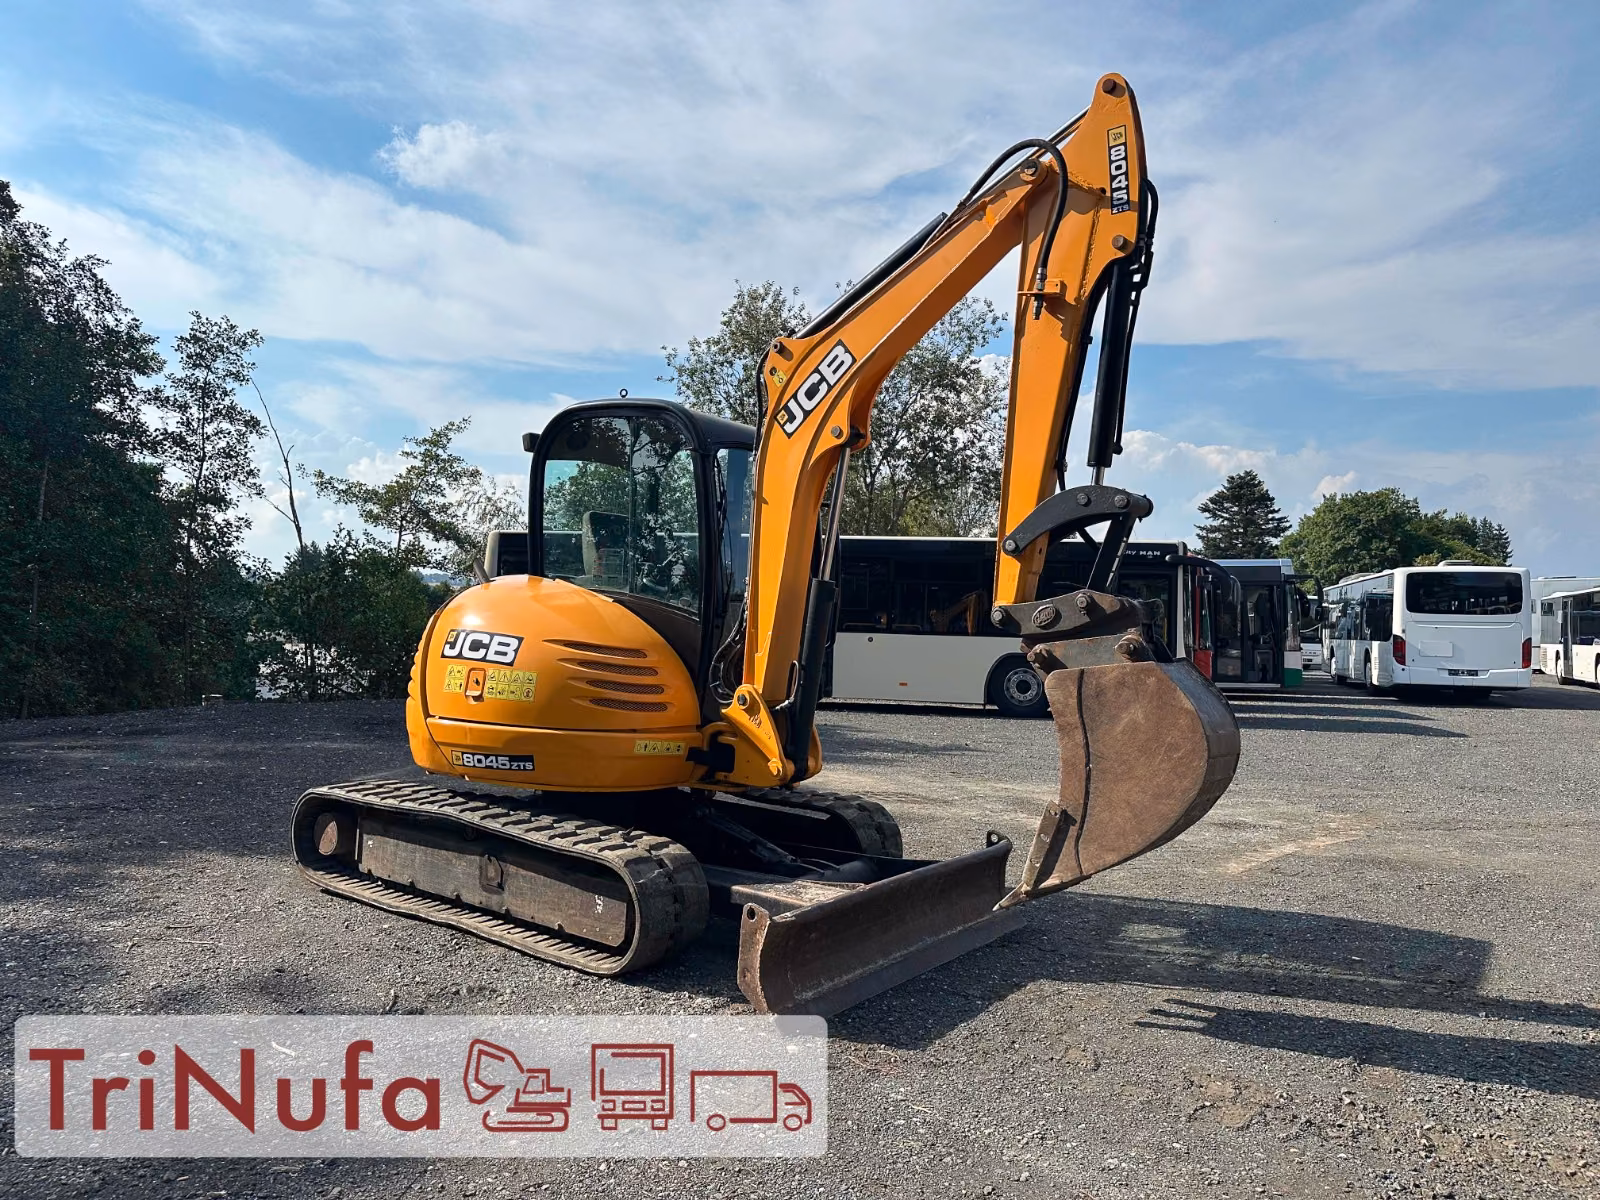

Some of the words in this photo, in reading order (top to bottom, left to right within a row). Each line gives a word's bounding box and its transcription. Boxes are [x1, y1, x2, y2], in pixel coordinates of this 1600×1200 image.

[1110, 145, 1128, 205] 8045
[783, 345, 853, 434] JCB
[443, 631, 519, 663] JCB
